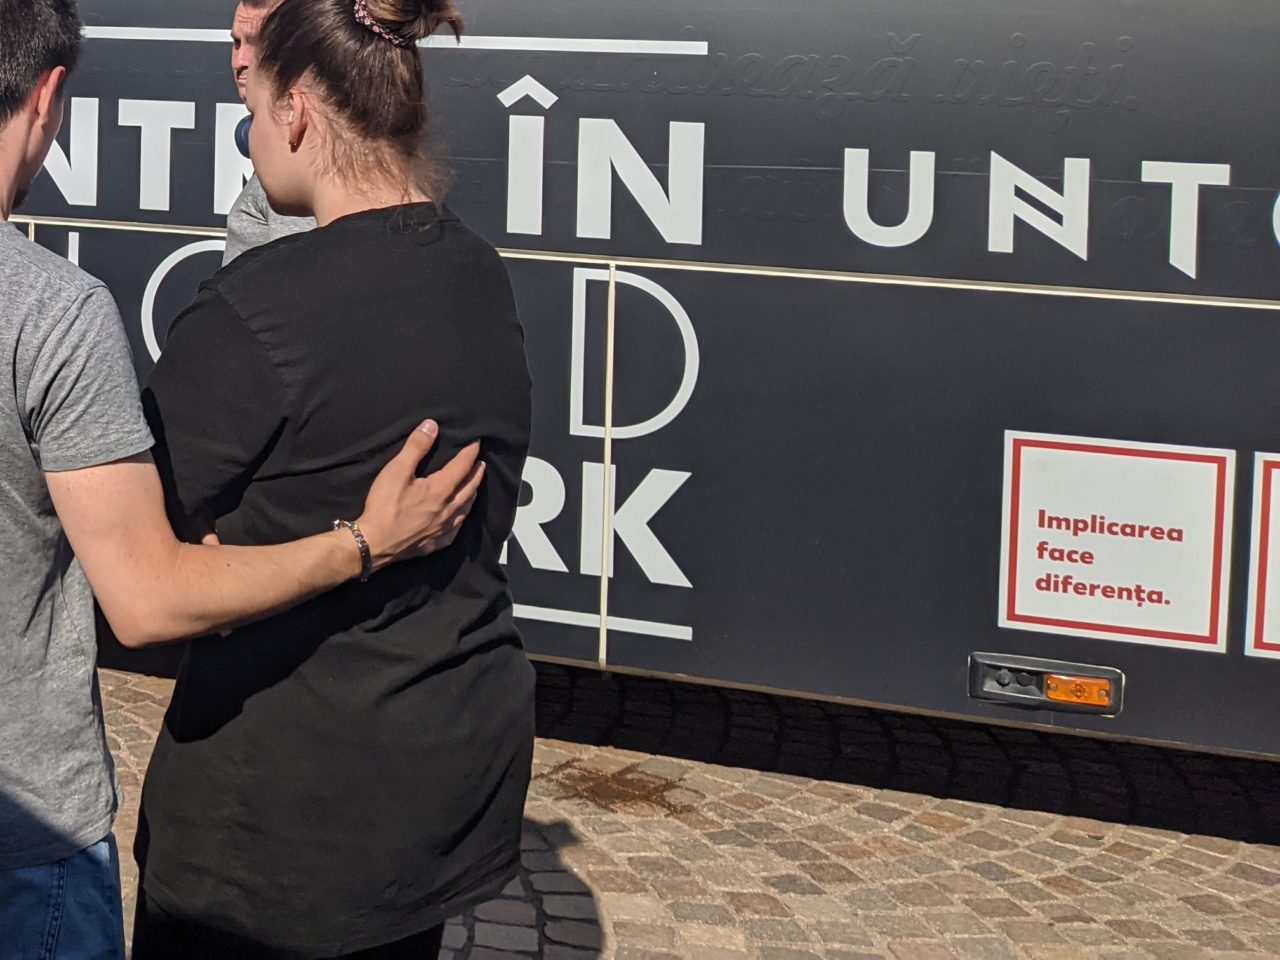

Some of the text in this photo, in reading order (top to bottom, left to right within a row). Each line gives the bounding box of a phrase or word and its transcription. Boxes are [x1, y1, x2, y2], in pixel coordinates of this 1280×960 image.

[496, 74, 707, 245] ÎN
[842, 146, 1280, 280] UNT
[1036, 508, 1185, 543] Implicarea
[1035, 540, 1095, 565] face
[1034, 572, 1172, 608] diferența.
